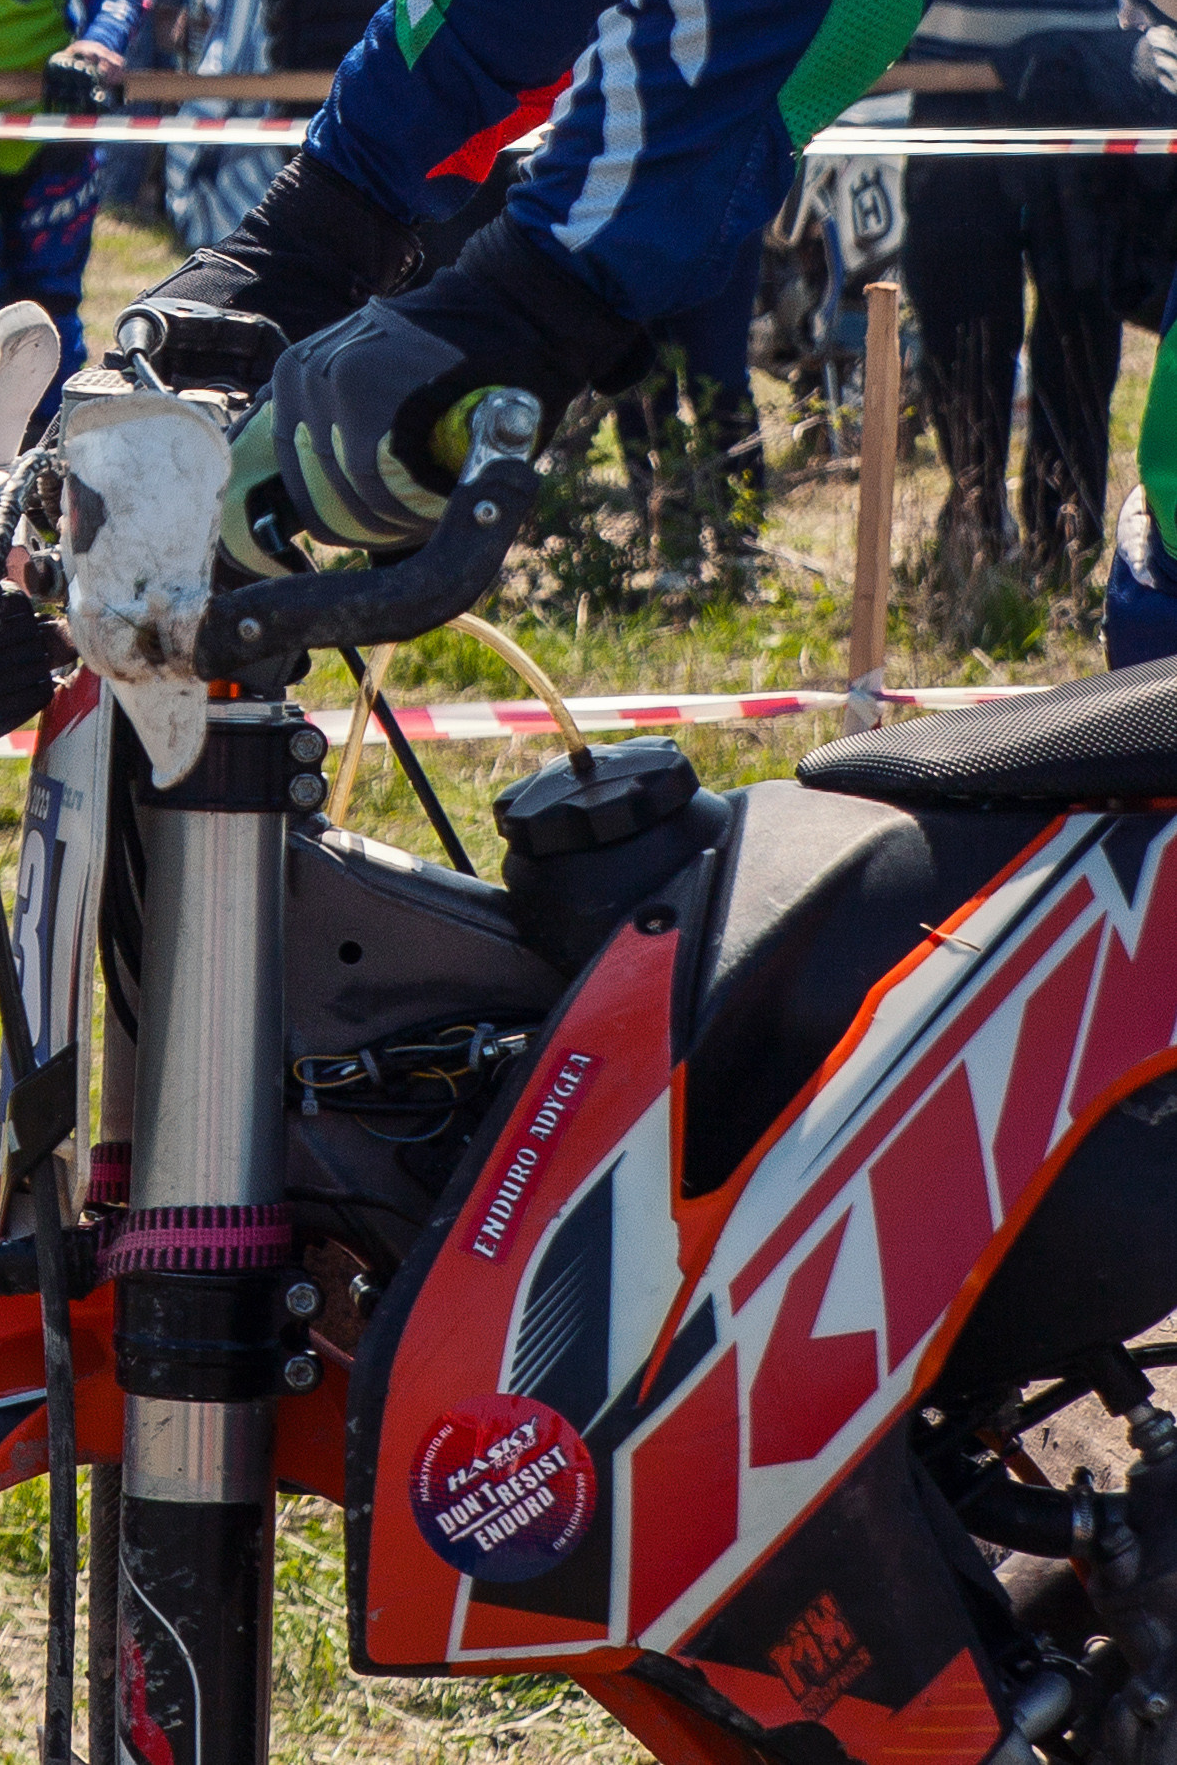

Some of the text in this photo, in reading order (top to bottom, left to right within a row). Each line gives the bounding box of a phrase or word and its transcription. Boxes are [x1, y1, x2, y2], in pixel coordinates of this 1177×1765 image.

[473, 1052, 592, 1259] ENDURO ADYGEA
[435, 1444, 569, 1536] DON'T RESIST
[446, 1415, 540, 1493] HASKY
[473, 1485, 556, 1553] ENDURO
